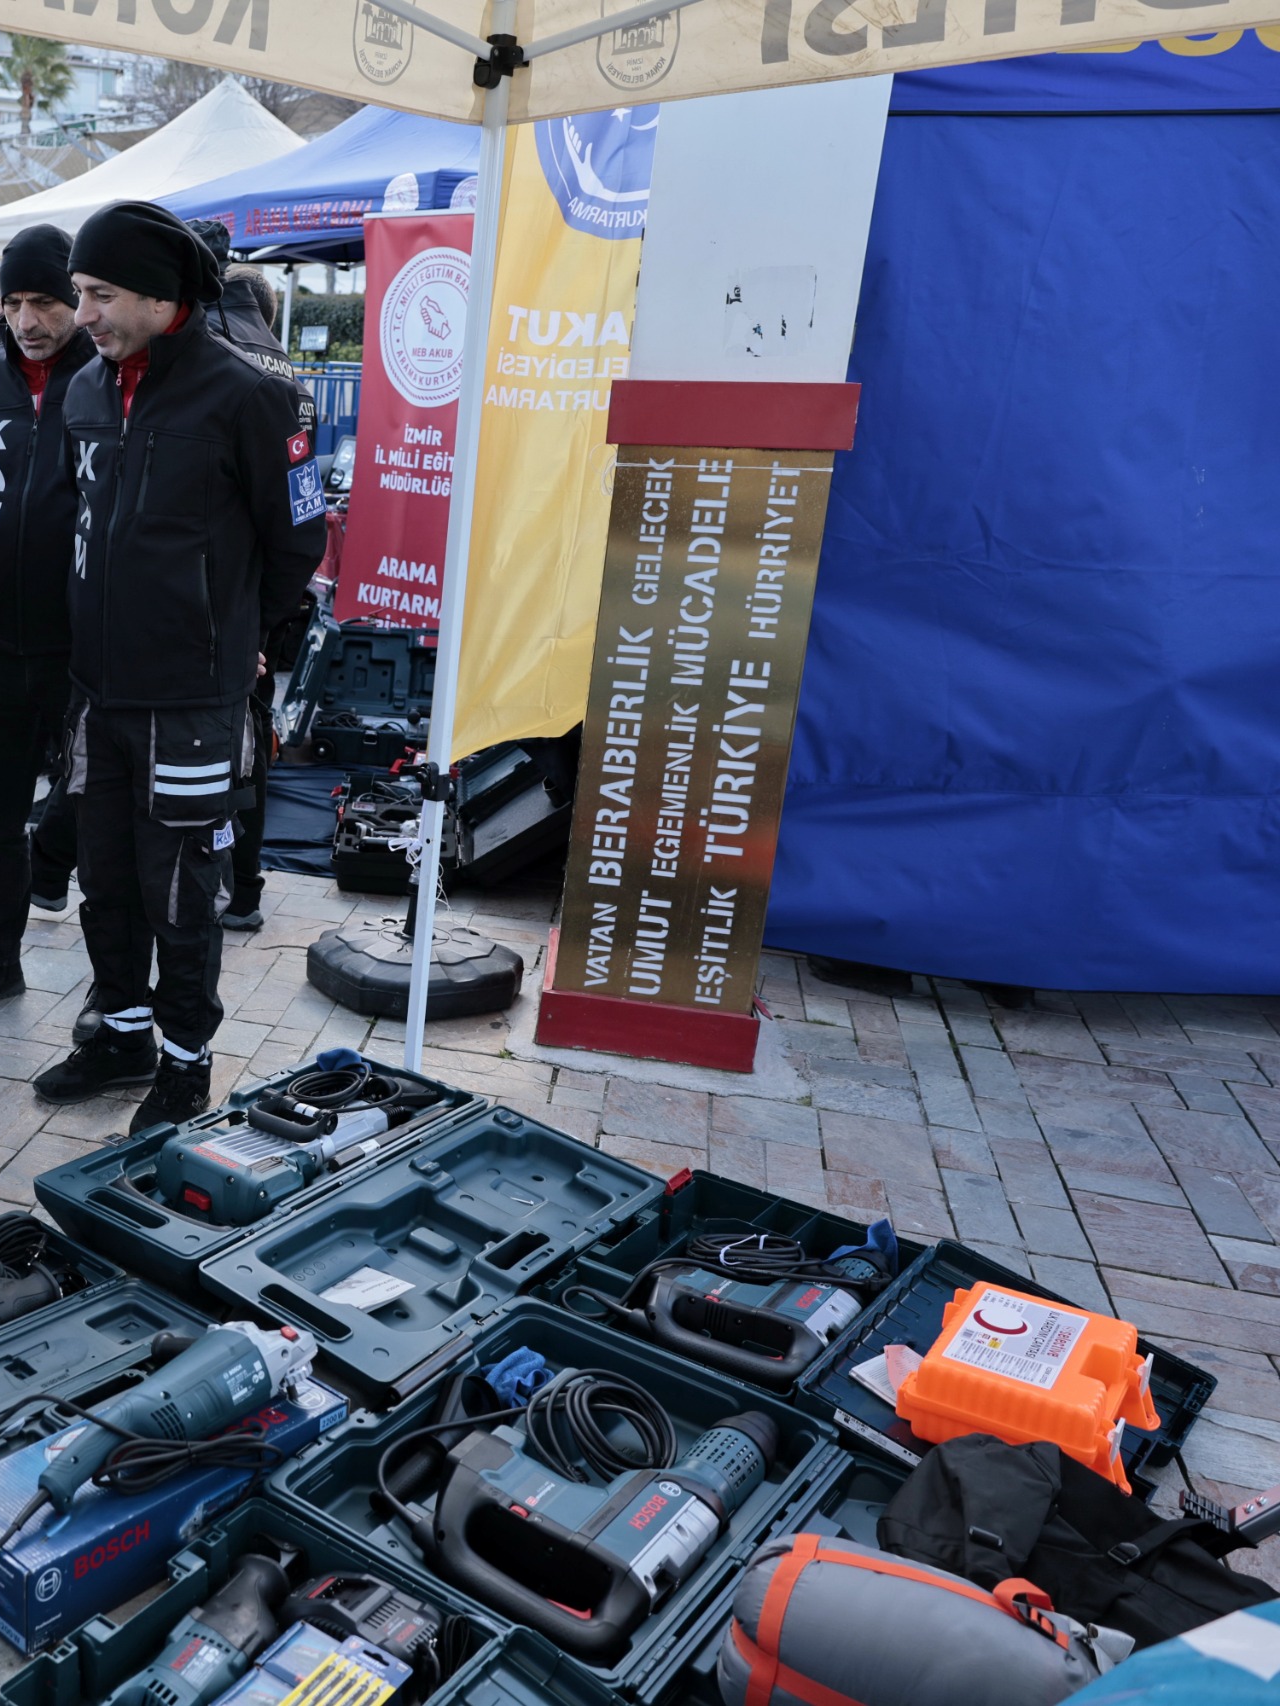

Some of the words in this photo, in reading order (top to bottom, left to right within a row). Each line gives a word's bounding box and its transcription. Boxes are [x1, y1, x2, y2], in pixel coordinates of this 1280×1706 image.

[244, 206, 291, 237] ARAMA
[293, 199, 373, 232] KURTARMA
[400, 275, 421, 307] MİLLİ
[419, 266, 454, 283] EĞİTİM
[411, 346, 427, 358] MEB
[428, 347, 454, 359] AKUB
[404, 423, 443, 447] İZMİR
[374, 444, 387, 465] İL
[388, 446, 420, 469] MİLLİ
[296, 496, 322, 516] KAM
[631, 456, 676, 607] GELECEK
[745, 460, 802, 640] HÜRRİYET
[376, 556, 438, 586] ARAMA
[666, 457, 734, 687] MÜCADELE
[587, 626, 654, 888] BERABERLİK
[698, 658, 772, 864] TÜRKİYE
[650, 701, 701, 879] EGEMENLİK
[582, 902, 619, 988] VATAN
[628, 889, 673, 997] UMUT
[693, 886, 738, 1006] EŞİTLİK
[191, 1146, 240, 1169] BOSCH
[1036, 1318, 1056, 1338] YARDIM
[629, 1494, 669, 1531] BOSCH
[73, 1519, 151, 1580] BOSCH
[170, 1637, 203, 1671] BOSCH
